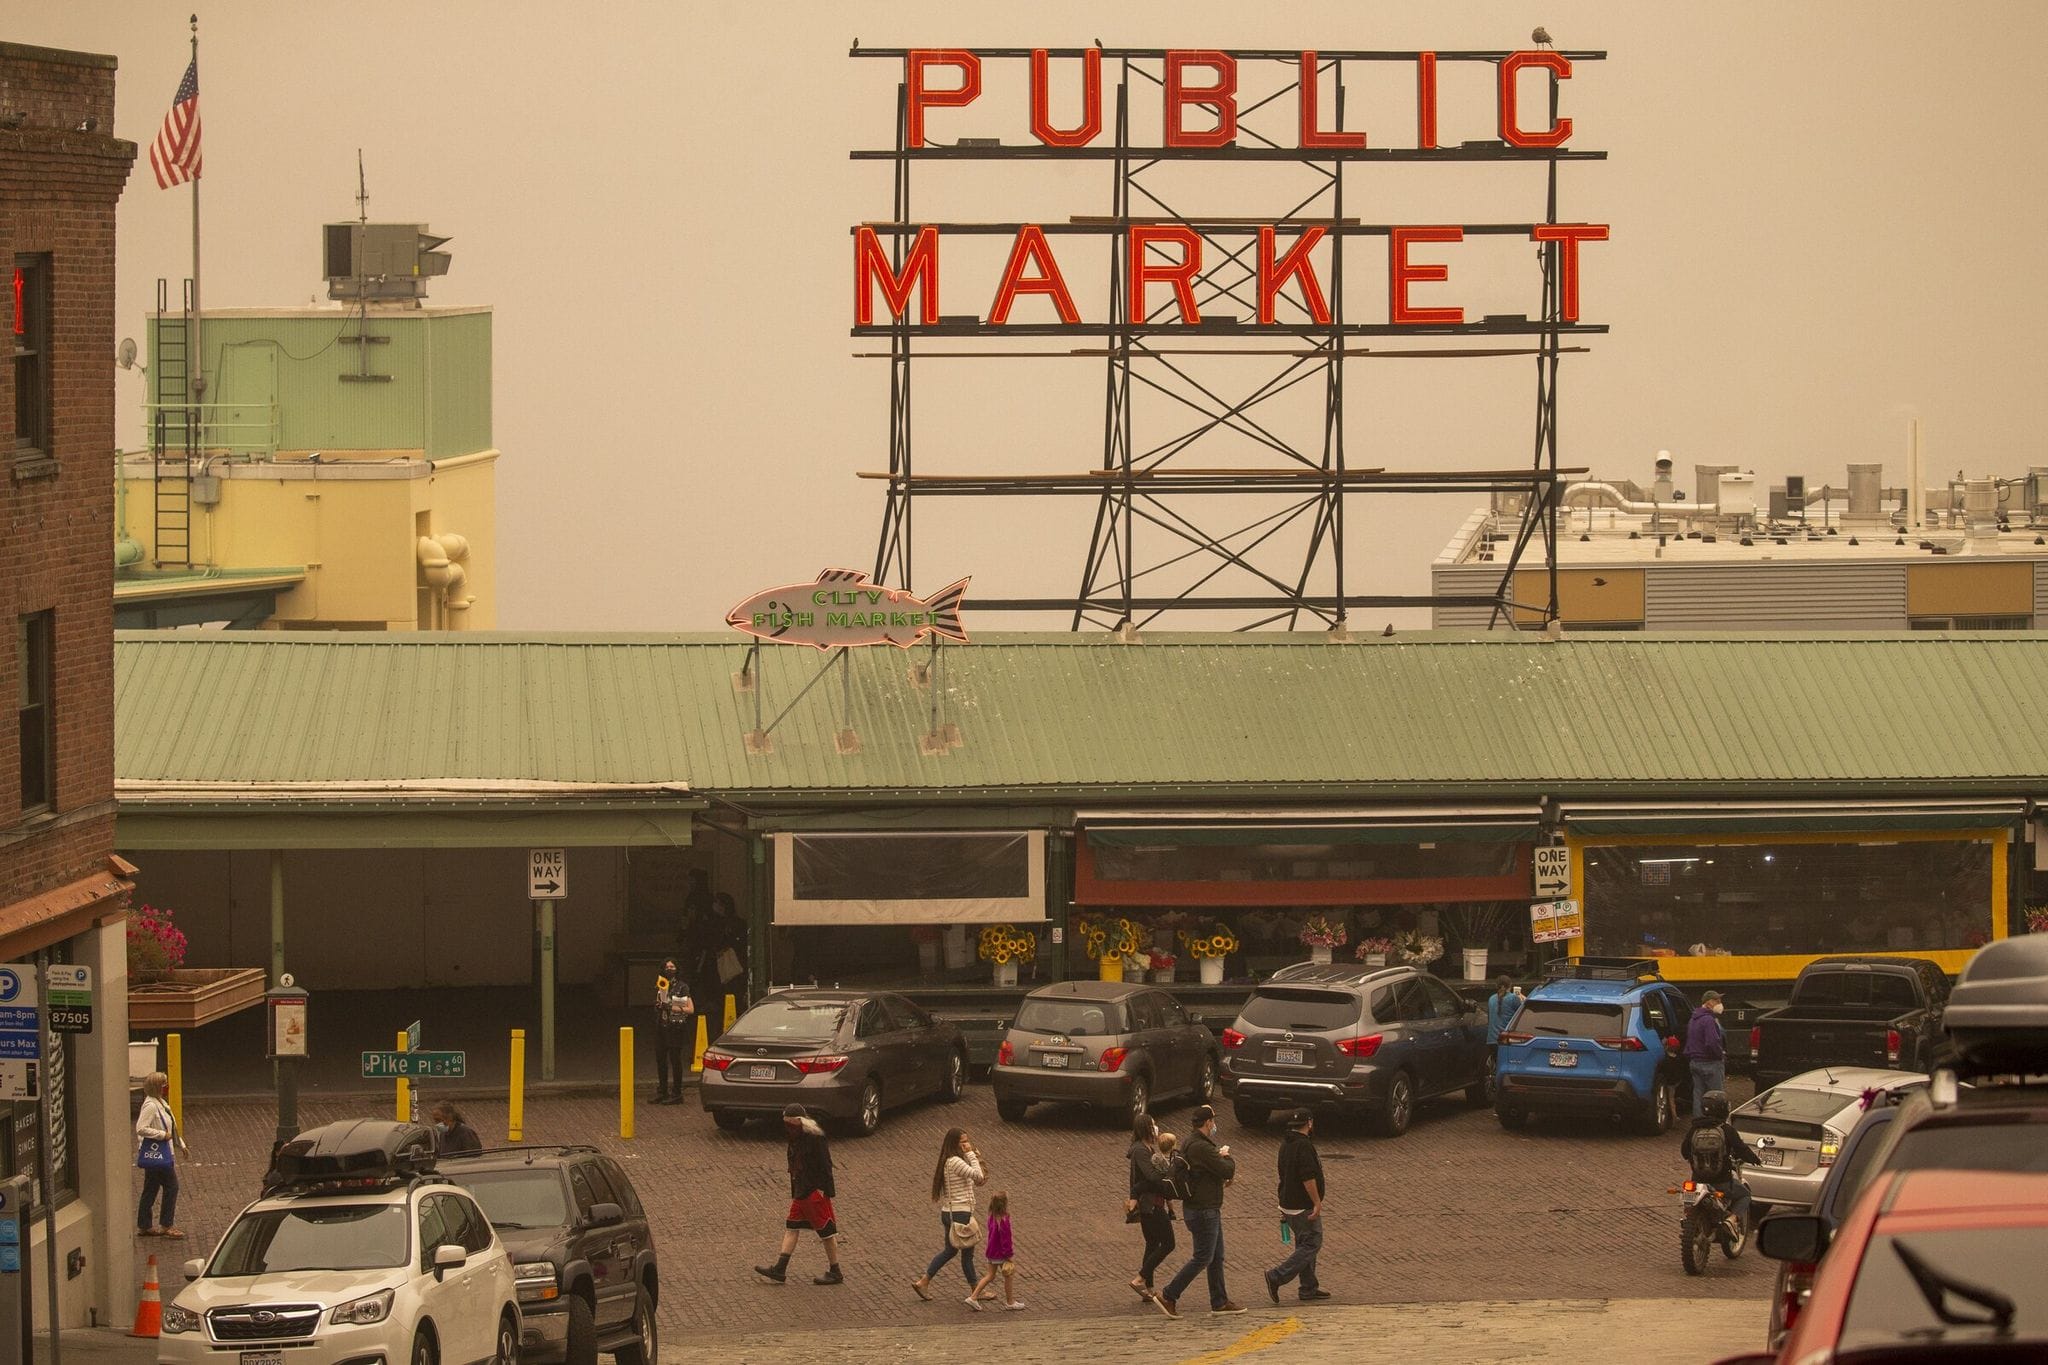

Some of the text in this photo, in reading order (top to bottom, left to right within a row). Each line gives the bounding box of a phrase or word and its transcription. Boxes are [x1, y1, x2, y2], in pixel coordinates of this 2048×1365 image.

[906, 48, 1573, 149] PUBLIC
[854, 225, 1609, 325] MARKET
[812, 590, 883, 606] CITY
[752, 611, 939, 628] FISH MARKET
[533, 852, 561, 864] ONE
[1538, 850, 1567, 862] ONE
[533, 866, 562, 878] WAY
[1538, 865, 1567, 877] WAY
[52, 1012, 89, 1024] 87505
[997, 1020, 1004, 1030] 2
[18, 1040, 36, 1048] Max
[370, 1055, 408, 1073] Pike
[418, 1061, 431, 1073] Pl
[16, 1112, 36, 1132] BAKERY
[18, 1136, 35, 1155] SINCE
[144, 1152, 163, 1160] DECA
